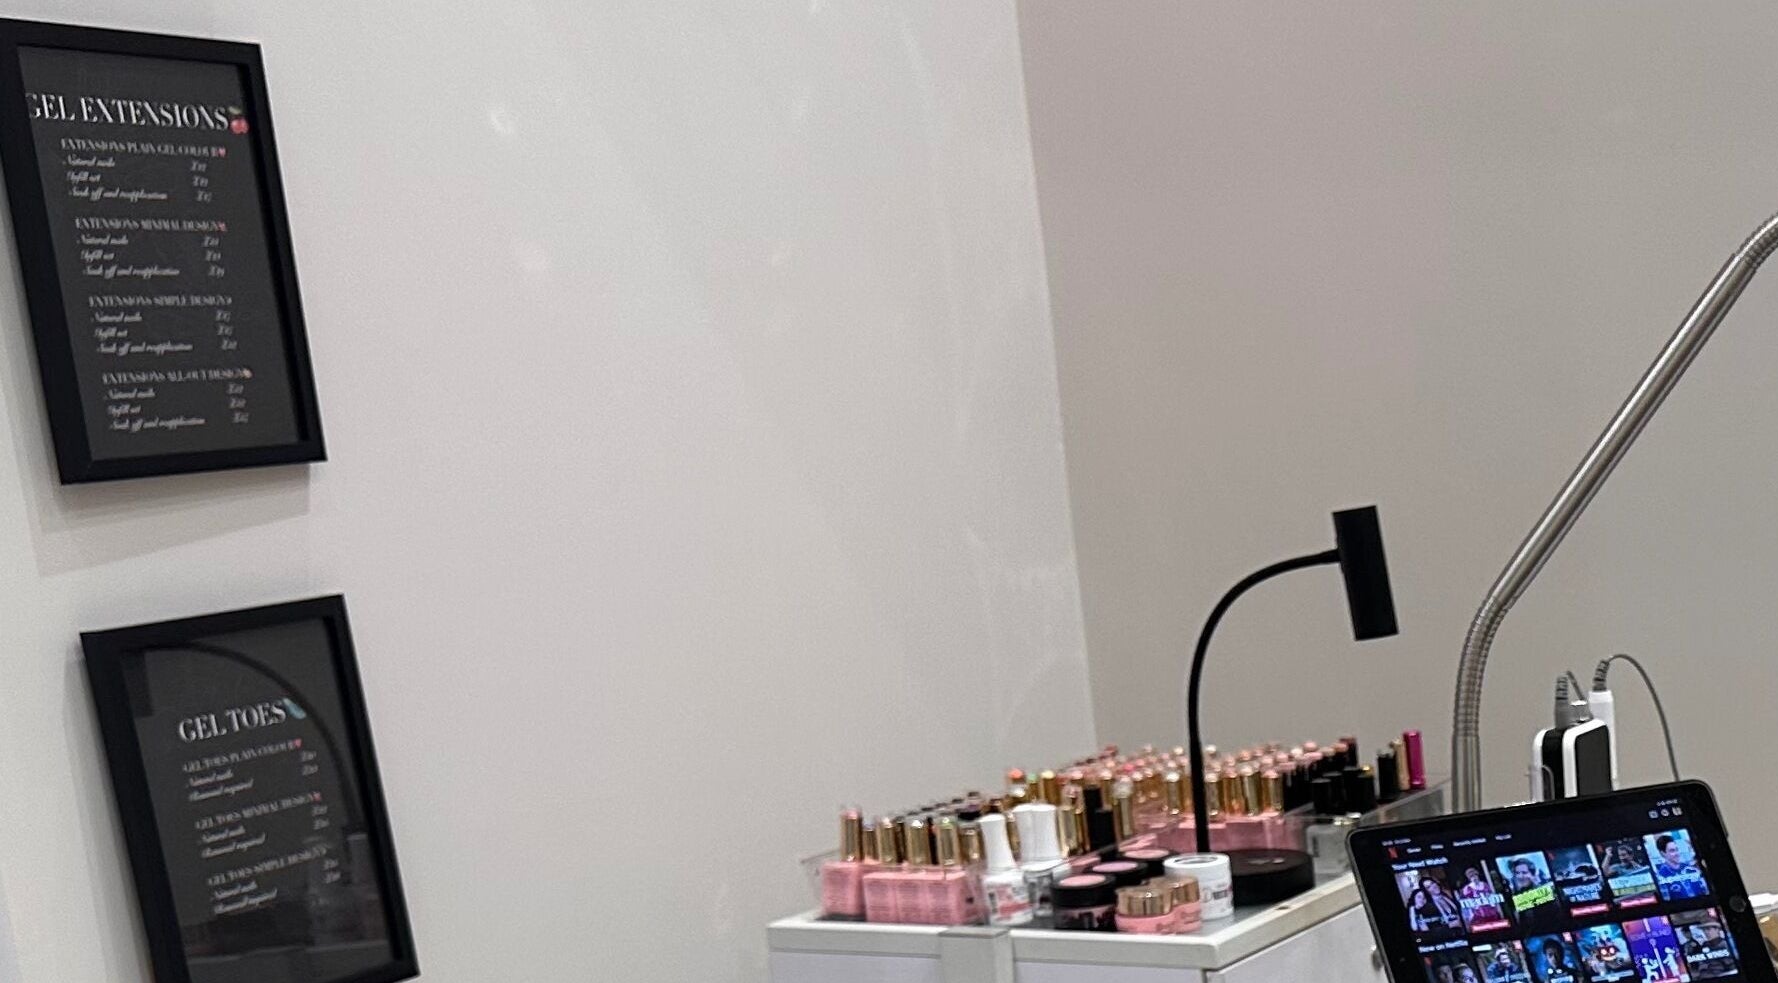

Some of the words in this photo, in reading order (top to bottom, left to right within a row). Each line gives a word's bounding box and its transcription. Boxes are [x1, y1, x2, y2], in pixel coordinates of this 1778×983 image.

[81, 96, 228, 131] EXTENSIONS
[178, 713, 227, 742] GEL
[225, 700, 287, 732] TOES
